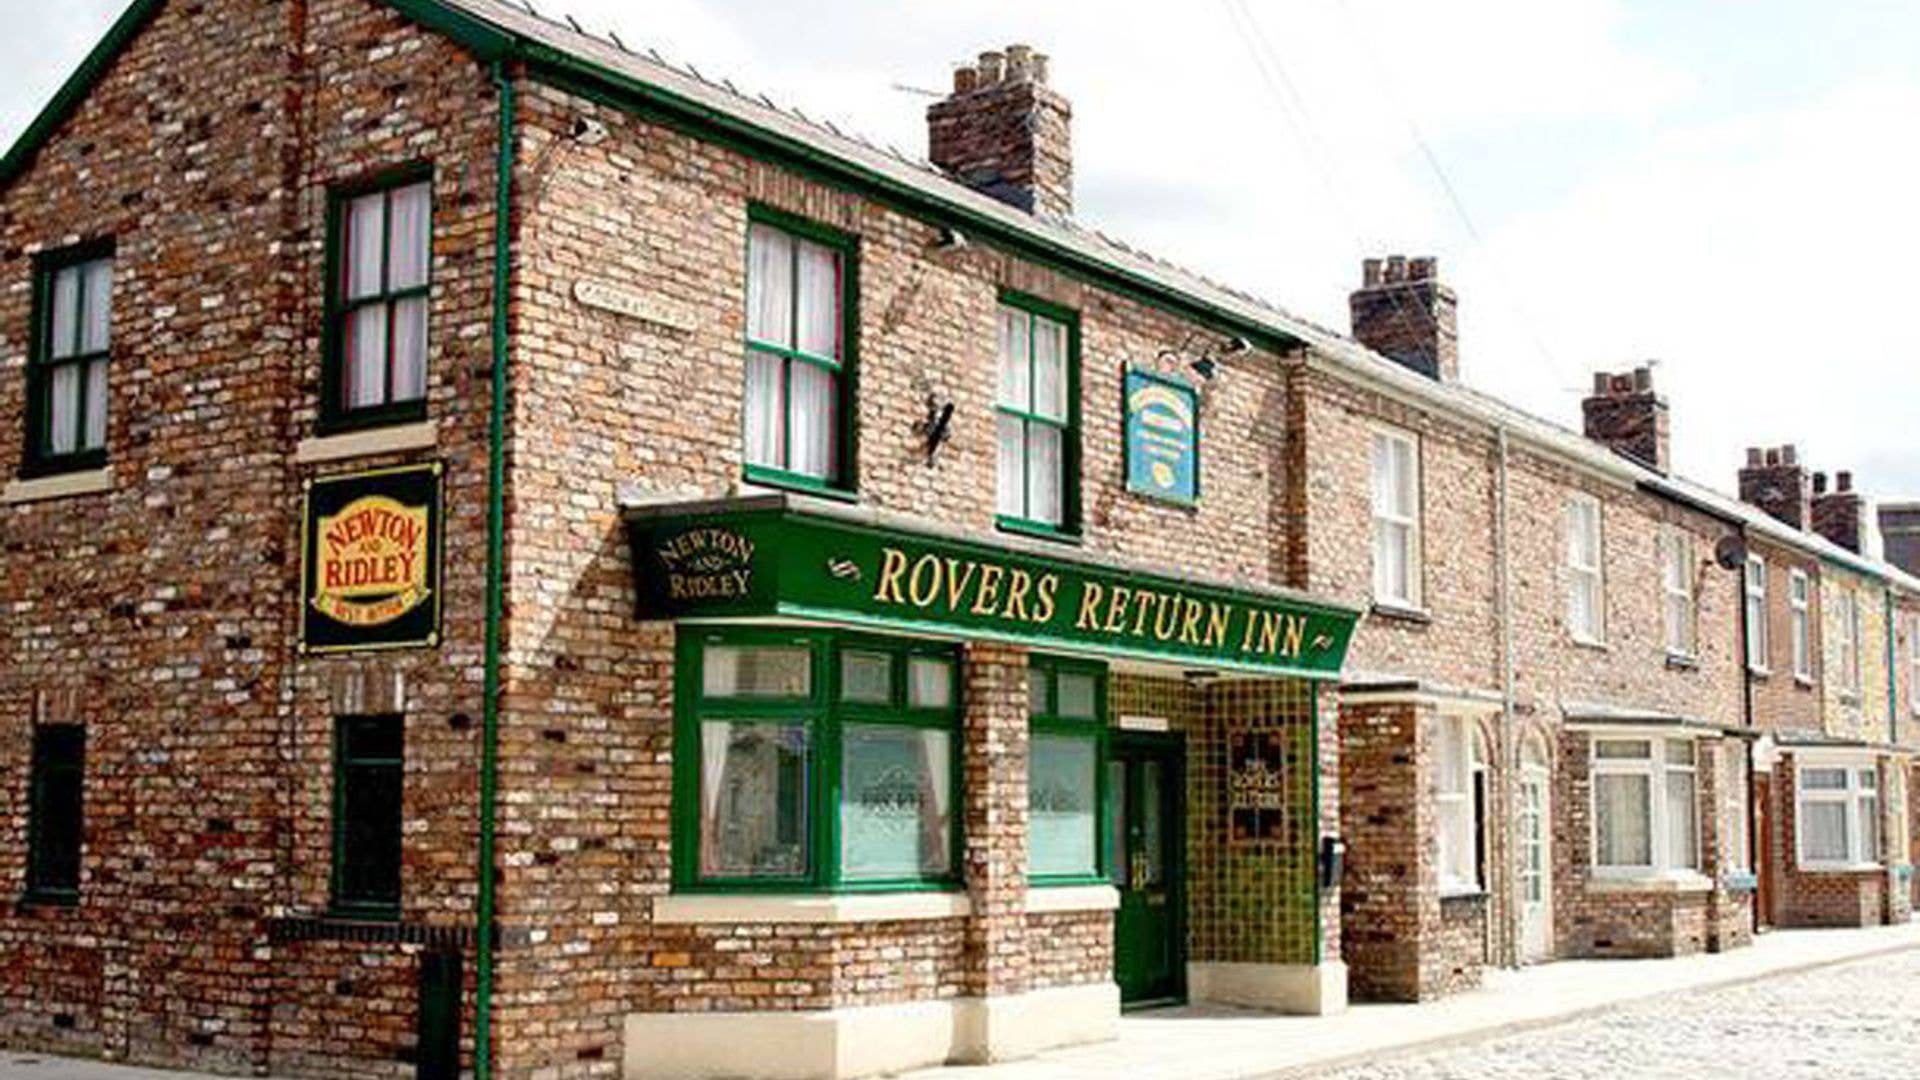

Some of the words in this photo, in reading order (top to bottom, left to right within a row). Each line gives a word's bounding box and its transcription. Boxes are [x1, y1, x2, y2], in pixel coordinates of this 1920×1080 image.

[325, 508, 423, 555] NEWTON
[659, 529, 754, 569] NEWTON
[325, 552, 416, 587] RIDLEY
[671, 569, 751, 597] RIDLEY
[874, 547, 1060, 623] ROVERS
[1076, 581, 1232, 648] RETURN
[1240, 609, 1308, 657] INN
